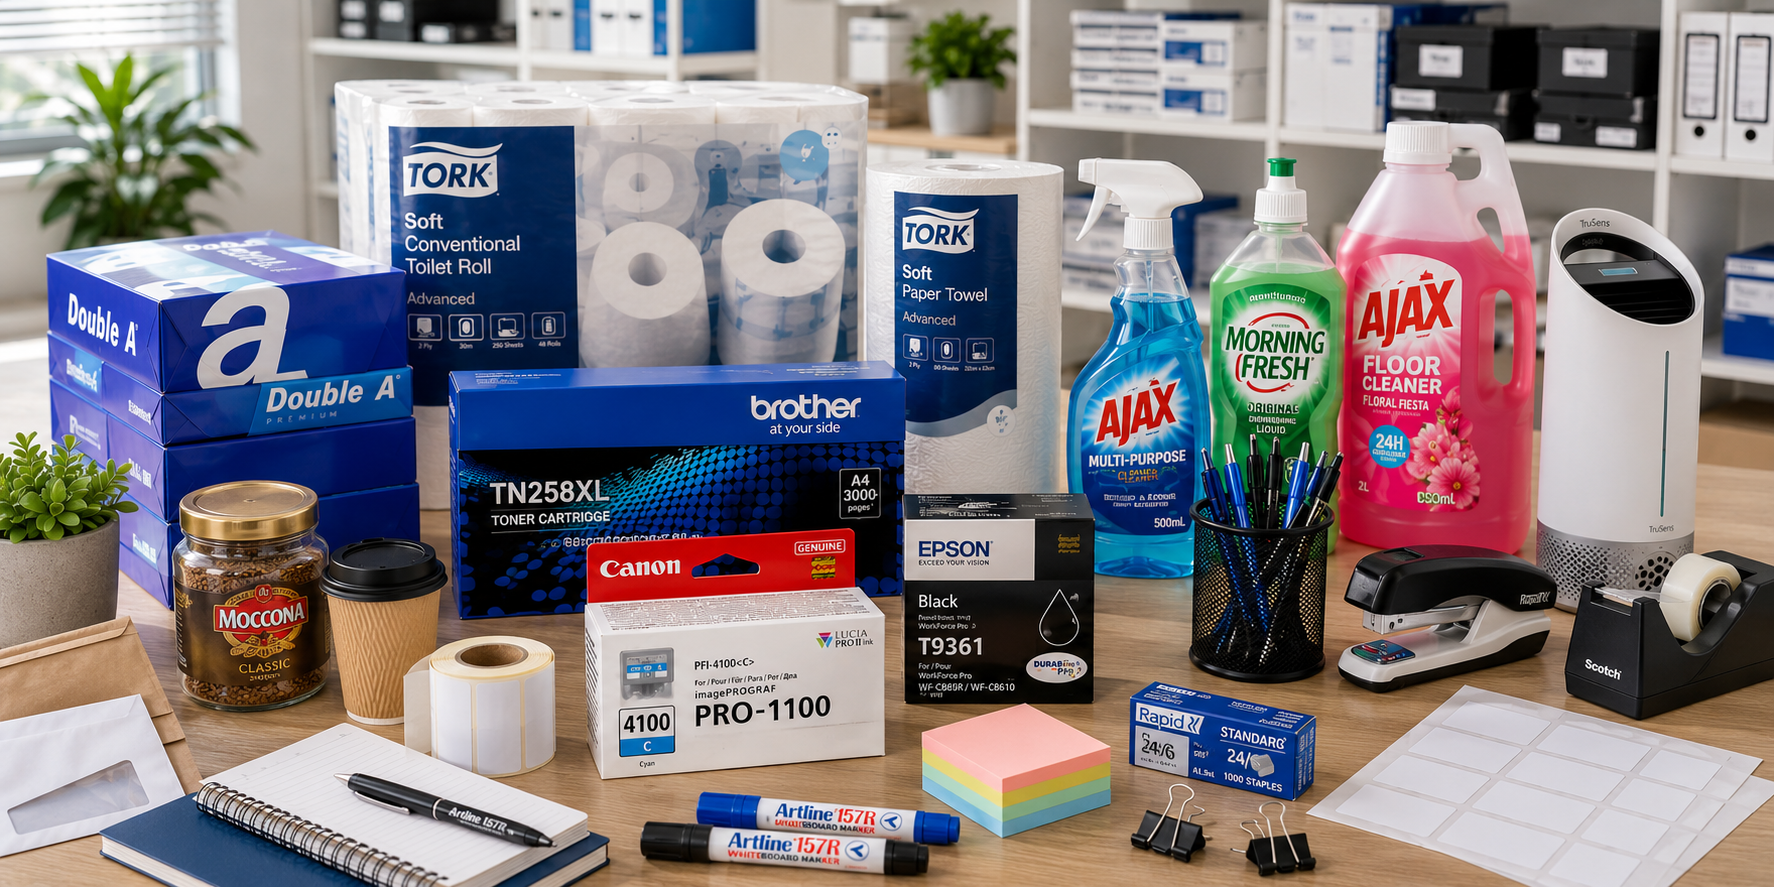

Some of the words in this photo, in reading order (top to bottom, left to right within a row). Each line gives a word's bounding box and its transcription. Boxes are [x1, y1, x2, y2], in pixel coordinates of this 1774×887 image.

[407, 162, 492, 189] TORK
[404, 212, 444, 230] Soft
[1579, 217, 1611, 229] TruSens
[404, 234, 521, 252] Conventional
[905, 222, 970, 246] TORK
[404, 257, 453, 275] Toilet
[458, 257, 492, 275] Roll
[902, 263, 933, 281] Soft
[406, 291, 476, 305] Advanced
[902, 283, 942, 303] Paper
[945, 287, 988, 302] Towel
[902, 310, 957, 326] Advanced
[1357, 278, 1456, 349] AJAX
[67, 292, 120, 348] Double
[124, 320, 137, 357] A
[1225, 325, 1326, 354] MORNING
[1241, 354, 1311, 381] FRESH
[1362, 354, 1441, 376] FLOOR
[265, 379, 364, 413] Double
[374, 374, 396, 401] A
[1361, 375, 1442, 395] CLEANER
[750, 393, 862, 421] brother
[1362, 394, 1397, 409] FLORAL
[1398, 398, 1430, 412] FIESTA
[266, 410, 338, 425] PREMIUM
[1095, 377, 1182, 448] AJAX
[769, 423, 783, 435] at
[784, 423, 814, 438] your
[815, 420, 841, 434] side
[1375, 433, 1404, 451] 24H
[1088, 448, 1187, 468] MULTI-PURPOSE
[850, 473, 870, 487] A4
[1357, 480, 1370, 493] 2L
[489, 479, 610, 505] TN258XL
[490, 513, 535, 526] TONER
[538, 510, 611, 525] CARTRIGGE
[1153, 516, 1187, 529] 500mL
[1648, 524, 1675, 533] TruSens
[797, 541, 843, 553] GENUINE
[918, 540, 990, 558] EPSON
[599, 558, 681, 578] Canon
[918, 594, 959, 609] Black
[218, 601, 305, 630] MOCCONA
[835, 629, 868, 640] LUCIA
[957, 622, 969, 630] Pro
[835, 638, 855, 648] PRO
[862, 638, 874, 646] ink
[917, 636, 983, 656] T9361
[238, 657, 292, 674] CLASSIC
[918, 662, 930, 670] For
[935, 662, 952, 670] Pour
[1584, 657, 1620, 681] Scotch
[959, 671, 973, 680] Pro
[694, 684, 777, 700] imagePROGRAF
[970, 682, 1016, 692] WF-C8610
[694, 694, 832, 728] PRO-1100
[1138, 706, 1185, 730] Rapid
[623, 712, 671, 734] 4100
[643, 740, 652, 752] C
[639, 760, 656, 769] Cyan
[1223, 771, 1244, 785] 1000
[1244, 776, 1284, 793] STAPLES
[447, 806, 482, 825] Artline
[774, 802, 834, 822] Artline
[836, 807, 877, 826] 157R
[727, 831, 793, 853] Artline
[796, 836, 841, 857] 157R
